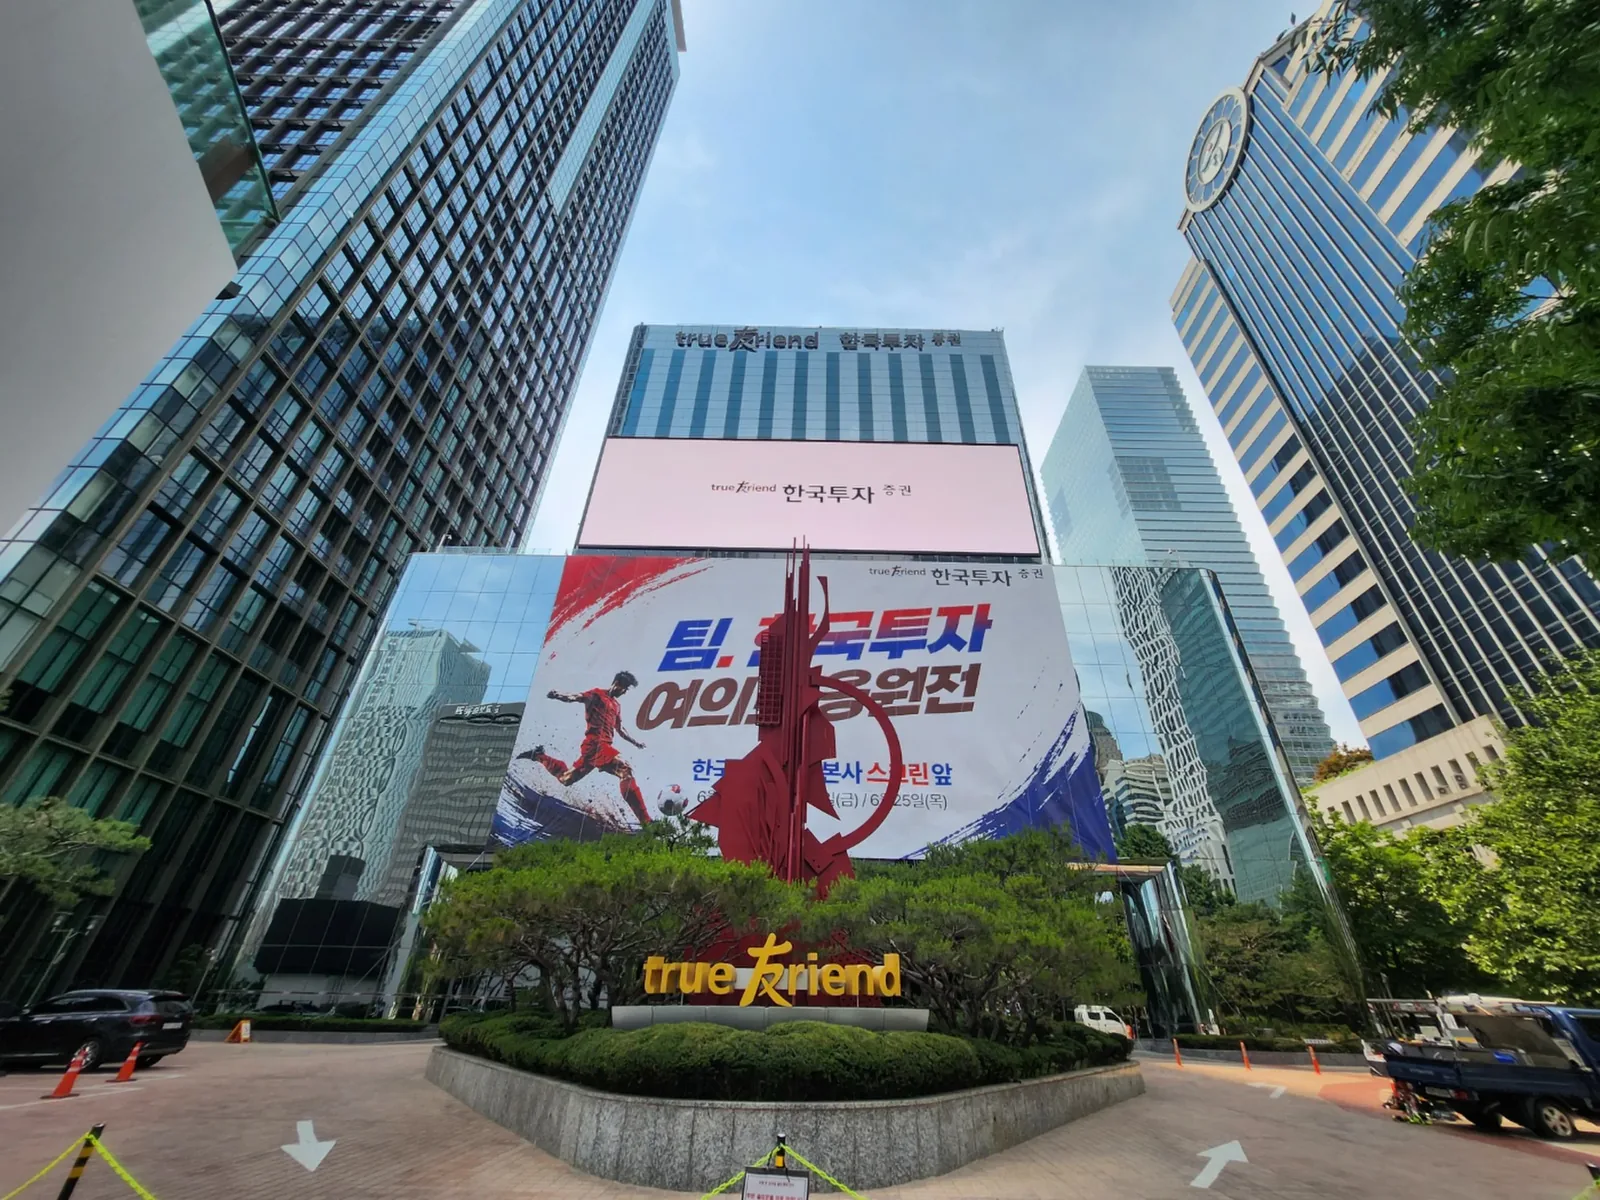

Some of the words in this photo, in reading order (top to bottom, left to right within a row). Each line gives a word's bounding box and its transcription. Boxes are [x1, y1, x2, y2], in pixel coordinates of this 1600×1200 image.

[839, 332, 926, 351] 한국투자
[931, 332, 962, 347] 증권
[782, 484, 875, 504] 한국투자
[881, 484, 912, 497] 증권
[931, 567, 1012, 587] 한국투자
[1018, 568, 1044, 580] 증권
[657, 617, 734, 672] 팀.
[636, 676, 760, 731] 여의
[822, 760, 863, 784] 본사
[931, 763, 953, 786] 앞
